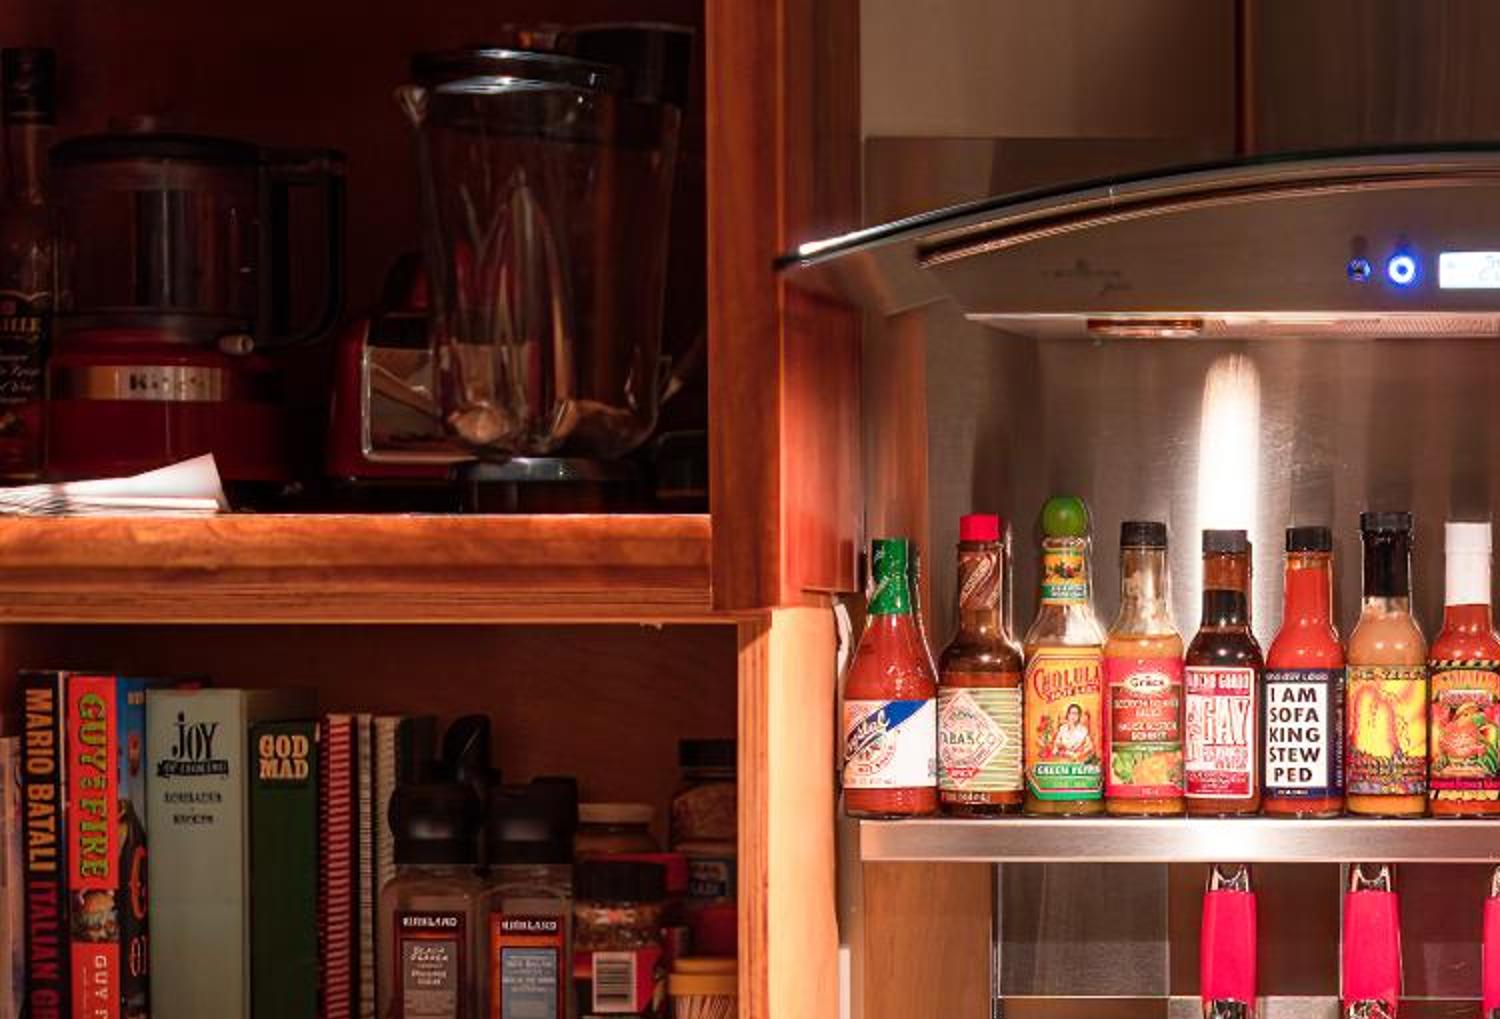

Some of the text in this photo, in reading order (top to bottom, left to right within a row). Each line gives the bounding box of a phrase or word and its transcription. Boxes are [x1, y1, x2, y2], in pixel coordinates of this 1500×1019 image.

[1270, 688, 1317, 702] I AM
[1269, 707, 1319, 722] SOFA
[25, 688, 55, 776] MARIO
[78, 692, 108, 774] GUY
[1269, 727, 1321, 743] KING
[259, 734, 310, 758] GOD
[1269, 747, 1321, 763] STEW
[259, 758, 310, 780] MAD
[1274, 767, 1313, 783] PED
[27, 783, 57, 872] BATALI
[79, 798, 109, 879] FIRE
[29, 880, 61, 980] ITALIAN
[95, 955, 108, 1001] GUY
